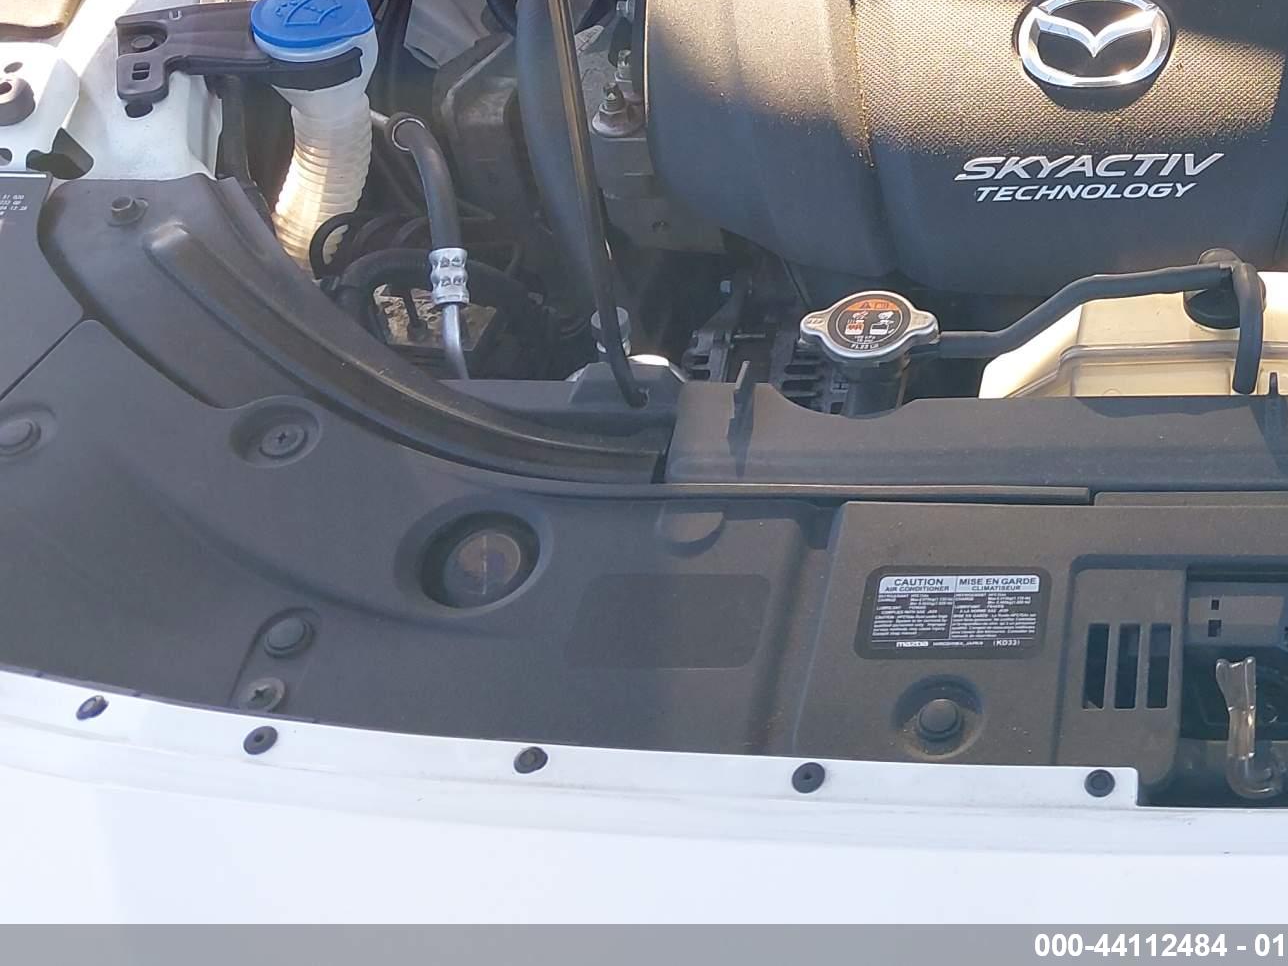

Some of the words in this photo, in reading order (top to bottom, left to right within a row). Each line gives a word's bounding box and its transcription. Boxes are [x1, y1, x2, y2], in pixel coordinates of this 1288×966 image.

[954, 153, 1224, 181] SKYACTIV
[976, 182, 1197, 202] TECHNOLOGY
[894, 578, 944, 586] CAUTION
[1001, 577, 1037, 585] GARDE
